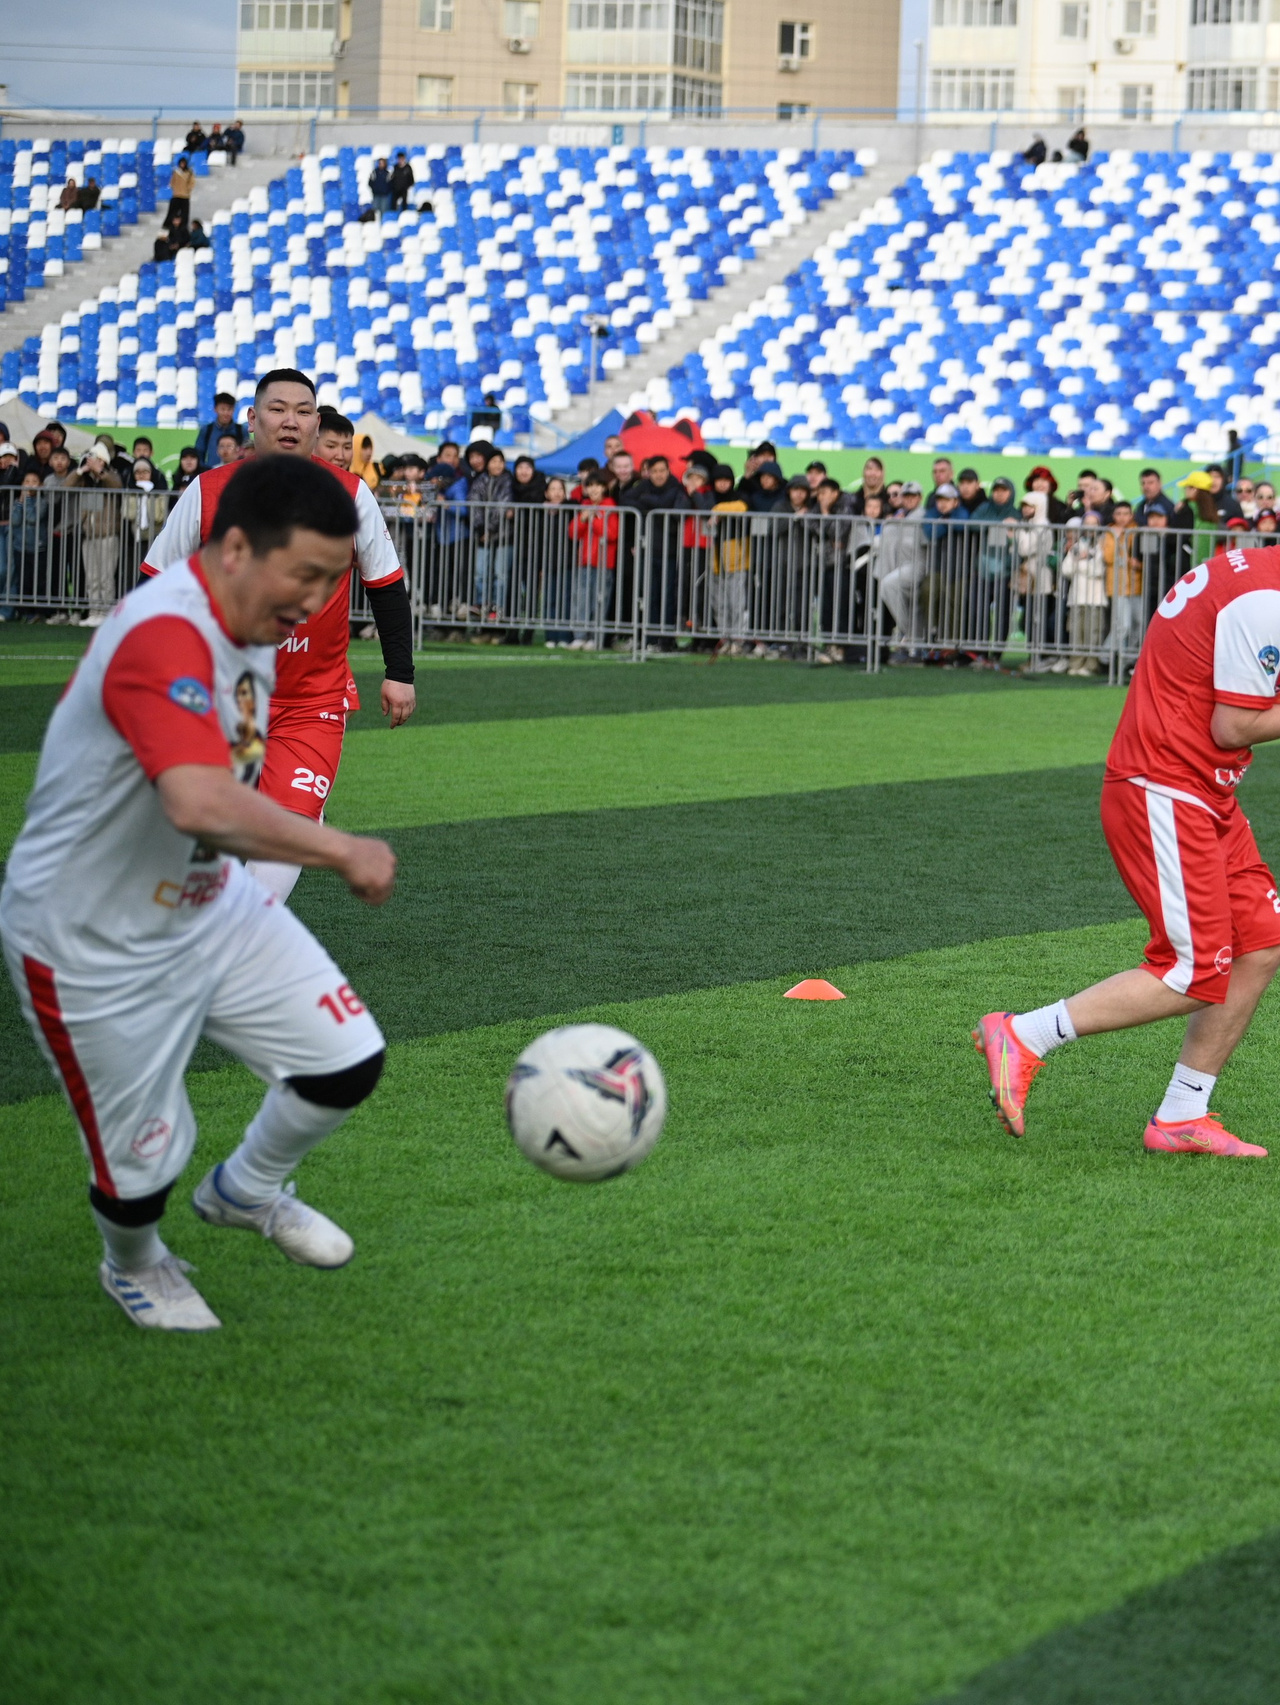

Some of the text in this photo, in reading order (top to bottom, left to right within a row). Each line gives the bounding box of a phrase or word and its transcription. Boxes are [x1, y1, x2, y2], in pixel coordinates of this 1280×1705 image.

[1157, 563, 1209, 619] 3
[291, 768, 331, 799] 29
[317, 984, 365, 1024] 16
